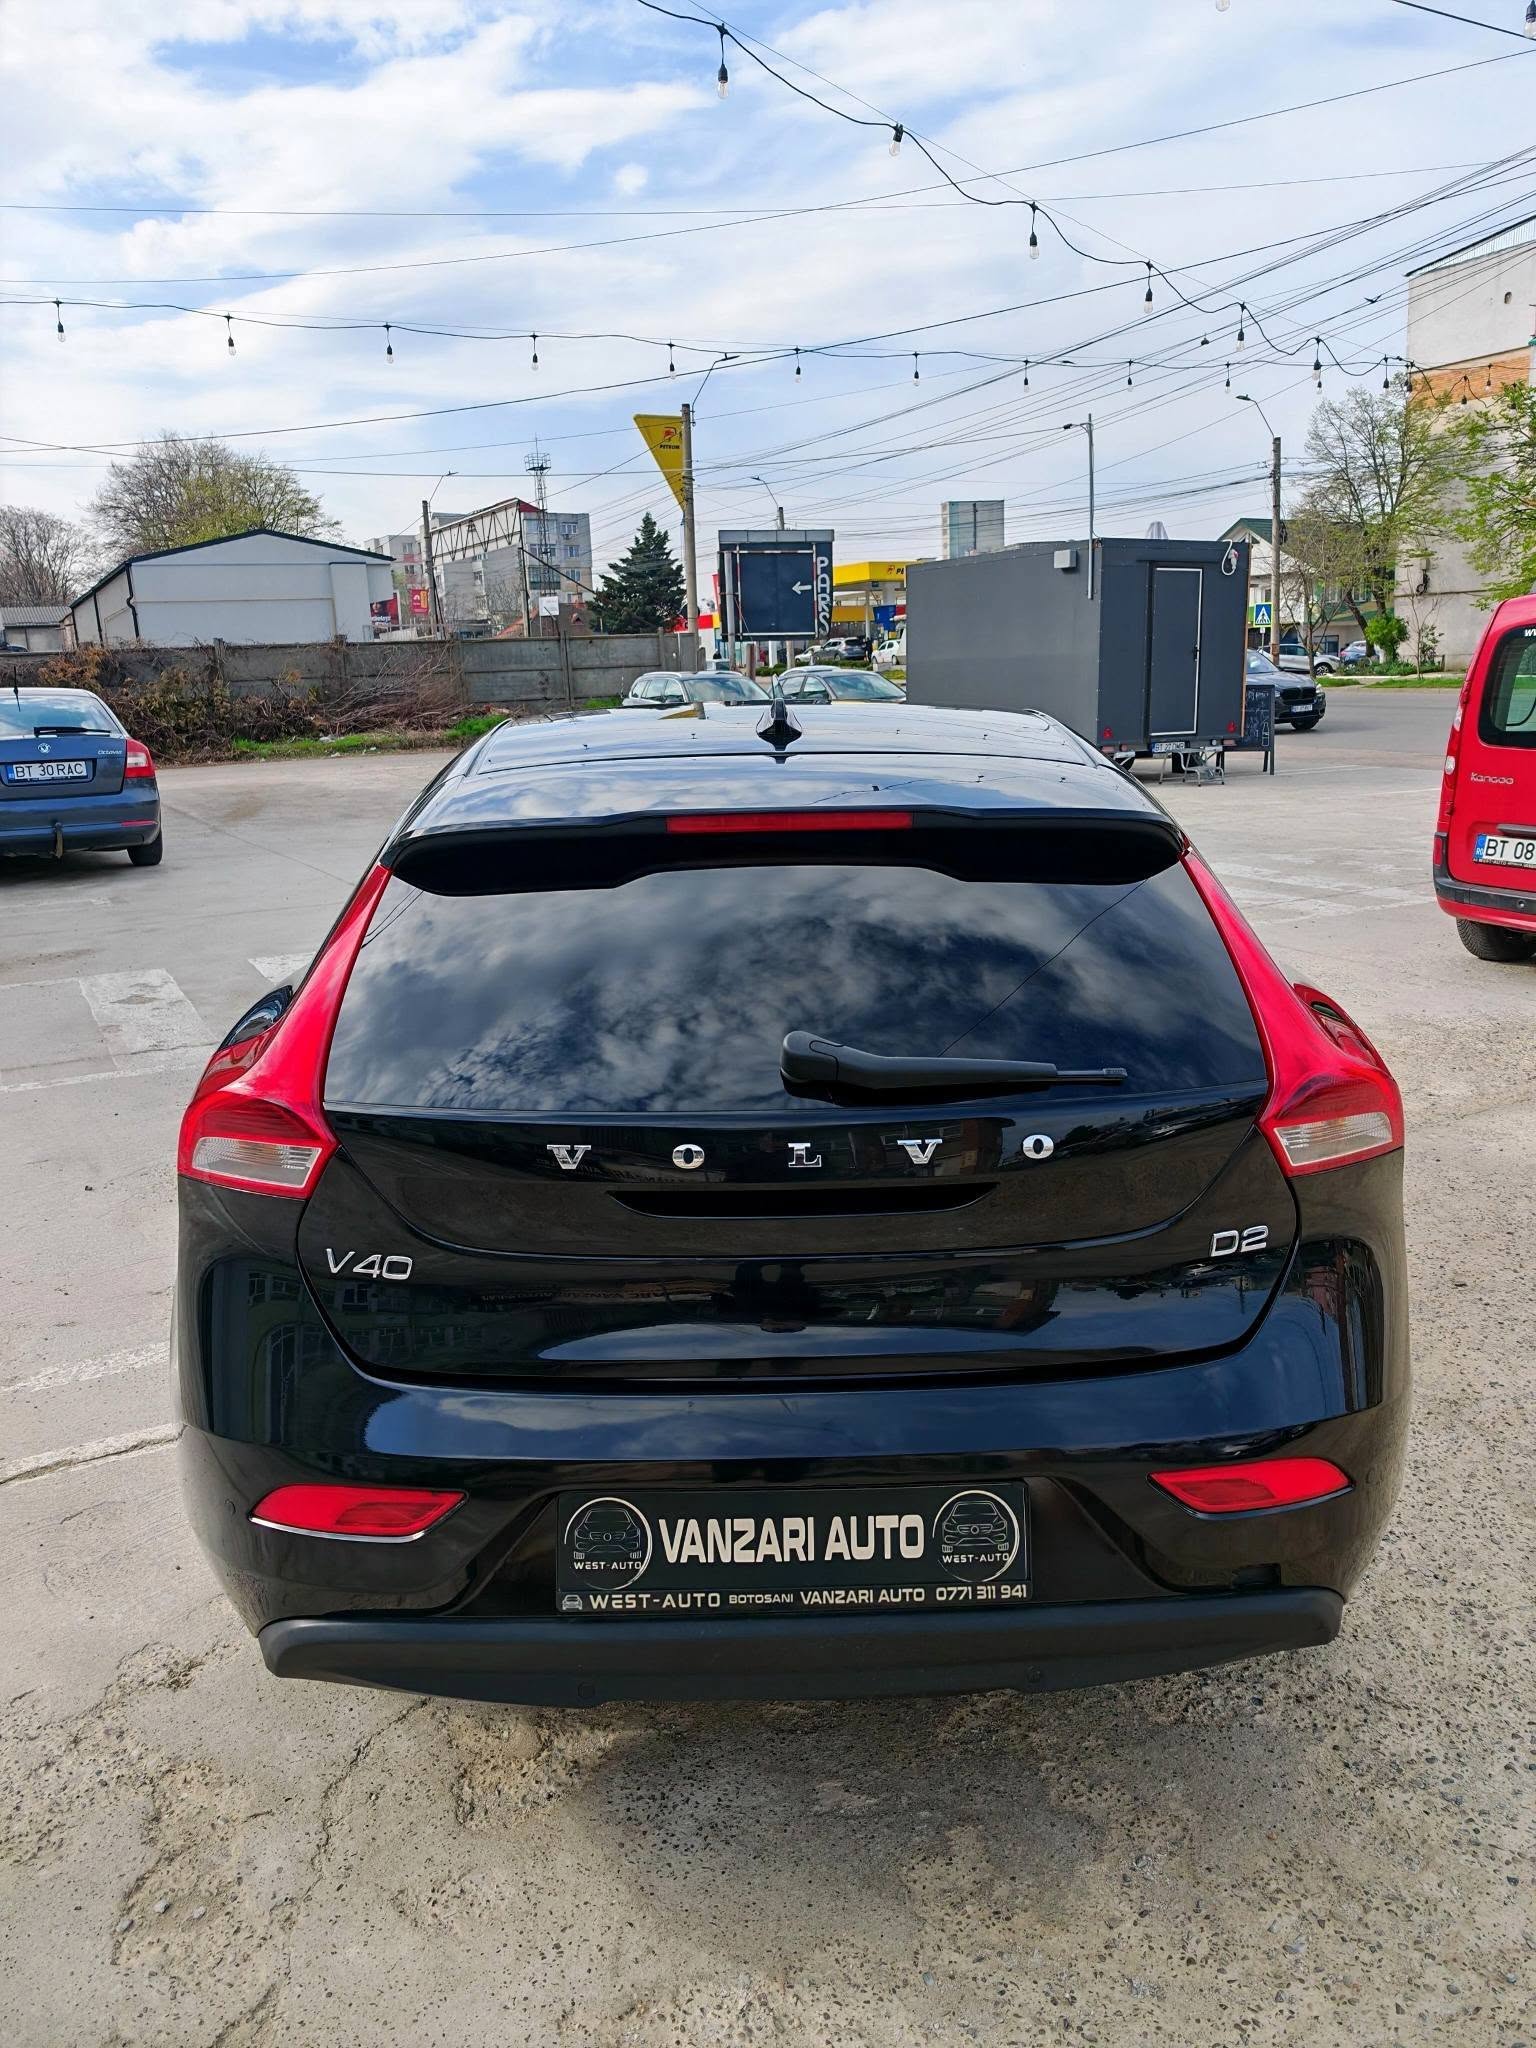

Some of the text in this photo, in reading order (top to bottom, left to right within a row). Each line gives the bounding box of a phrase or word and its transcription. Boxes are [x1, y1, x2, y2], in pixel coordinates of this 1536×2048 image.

[817, 556, 831, 635] PARS
[15, 762, 84, 778] BT 30 RAC
[1471, 772, 1514, 785] Kangoo
[1485, 838, 1535, 861] BT 08
[546, 1134, 1055, 1170] VOLVO
[1210, 1225, 1269, 1257] D2
[325, 1248, 413, 1280] V40
[658, 1514, 925, 1562] VANZARI AUTO
[573, 1561, 642, 1570] WEST-AUTO
[941, 1552, 1010, 1563] WEST-AUTO
[589, 1584, 1027, 1610] WEST-AUTO BOTOSANI VANZARI AUTO 0771 311 941
